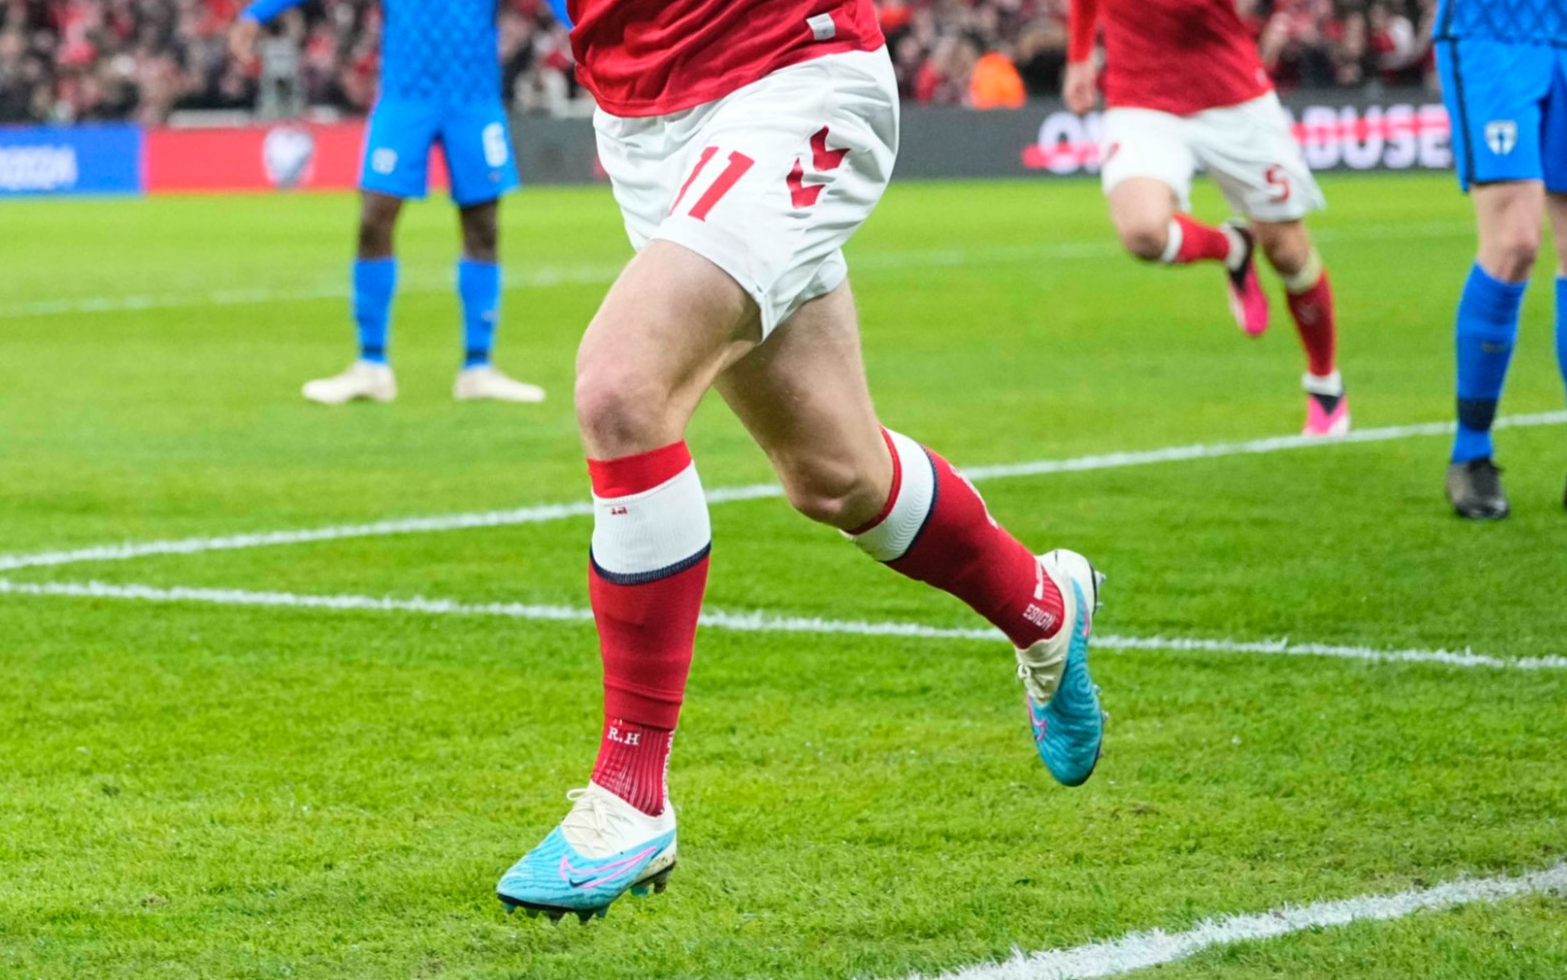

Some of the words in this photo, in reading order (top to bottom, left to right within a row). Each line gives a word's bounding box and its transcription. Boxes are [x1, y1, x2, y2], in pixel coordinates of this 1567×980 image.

[1295, 105, 1453, 171] BUSE
[670, 146, 755, 222] 11
[1023, 603, 1057, 632] ESIGN
[607, 726, 641, 747] R.H
